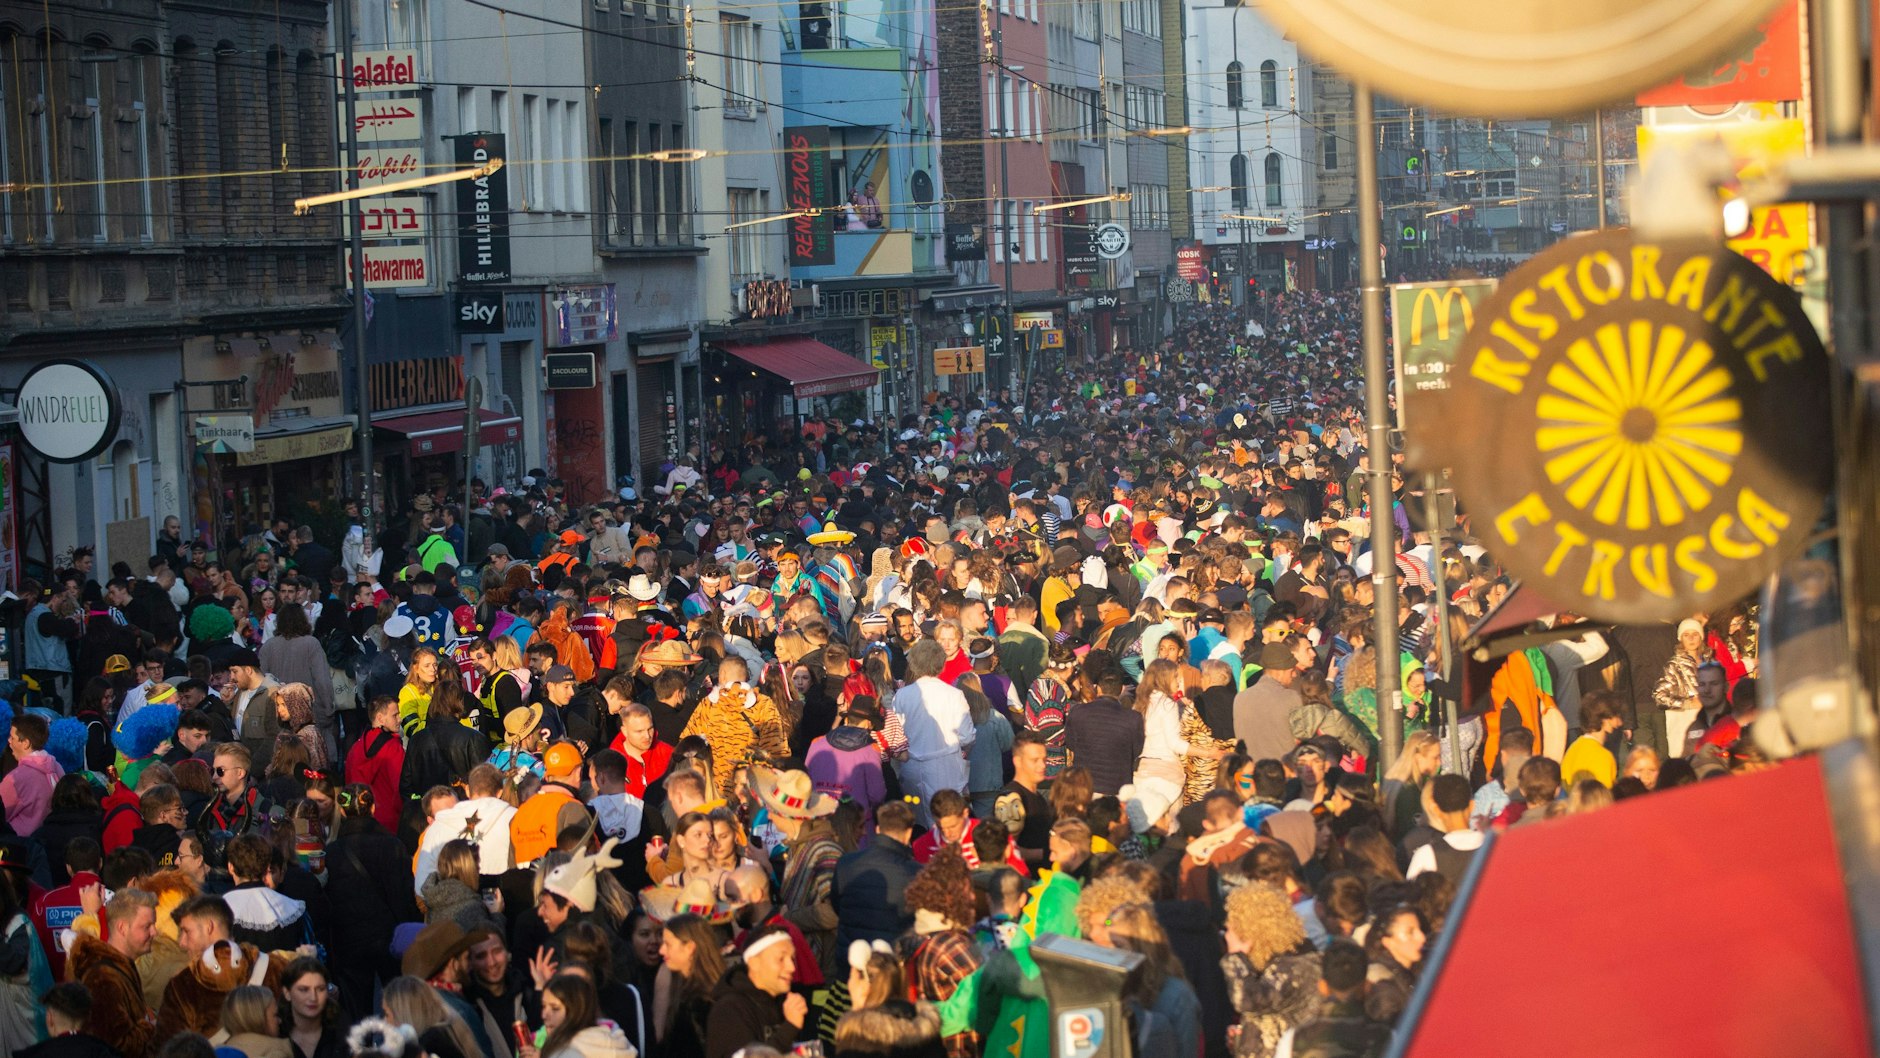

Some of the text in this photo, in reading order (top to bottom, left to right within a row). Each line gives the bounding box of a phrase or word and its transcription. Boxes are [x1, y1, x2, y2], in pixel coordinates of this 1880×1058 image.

[474, 138, 493, 265] HILLEBRADS
[1177, 250, 1201, 258] KIOSK
[349, 254, 424, 283] hawarma
[461, 301, 498, 325] sky
[1097, 295, 1118, 307] sky
[505, 301, 536, 328] OLOURS
[1470, 244, 1804, 394] RISTORANTE
[1403, 363, 1419, 376] in
[20, 396, 105, 424] WNDRFUEL
[414, 616, 432, 642] 3
